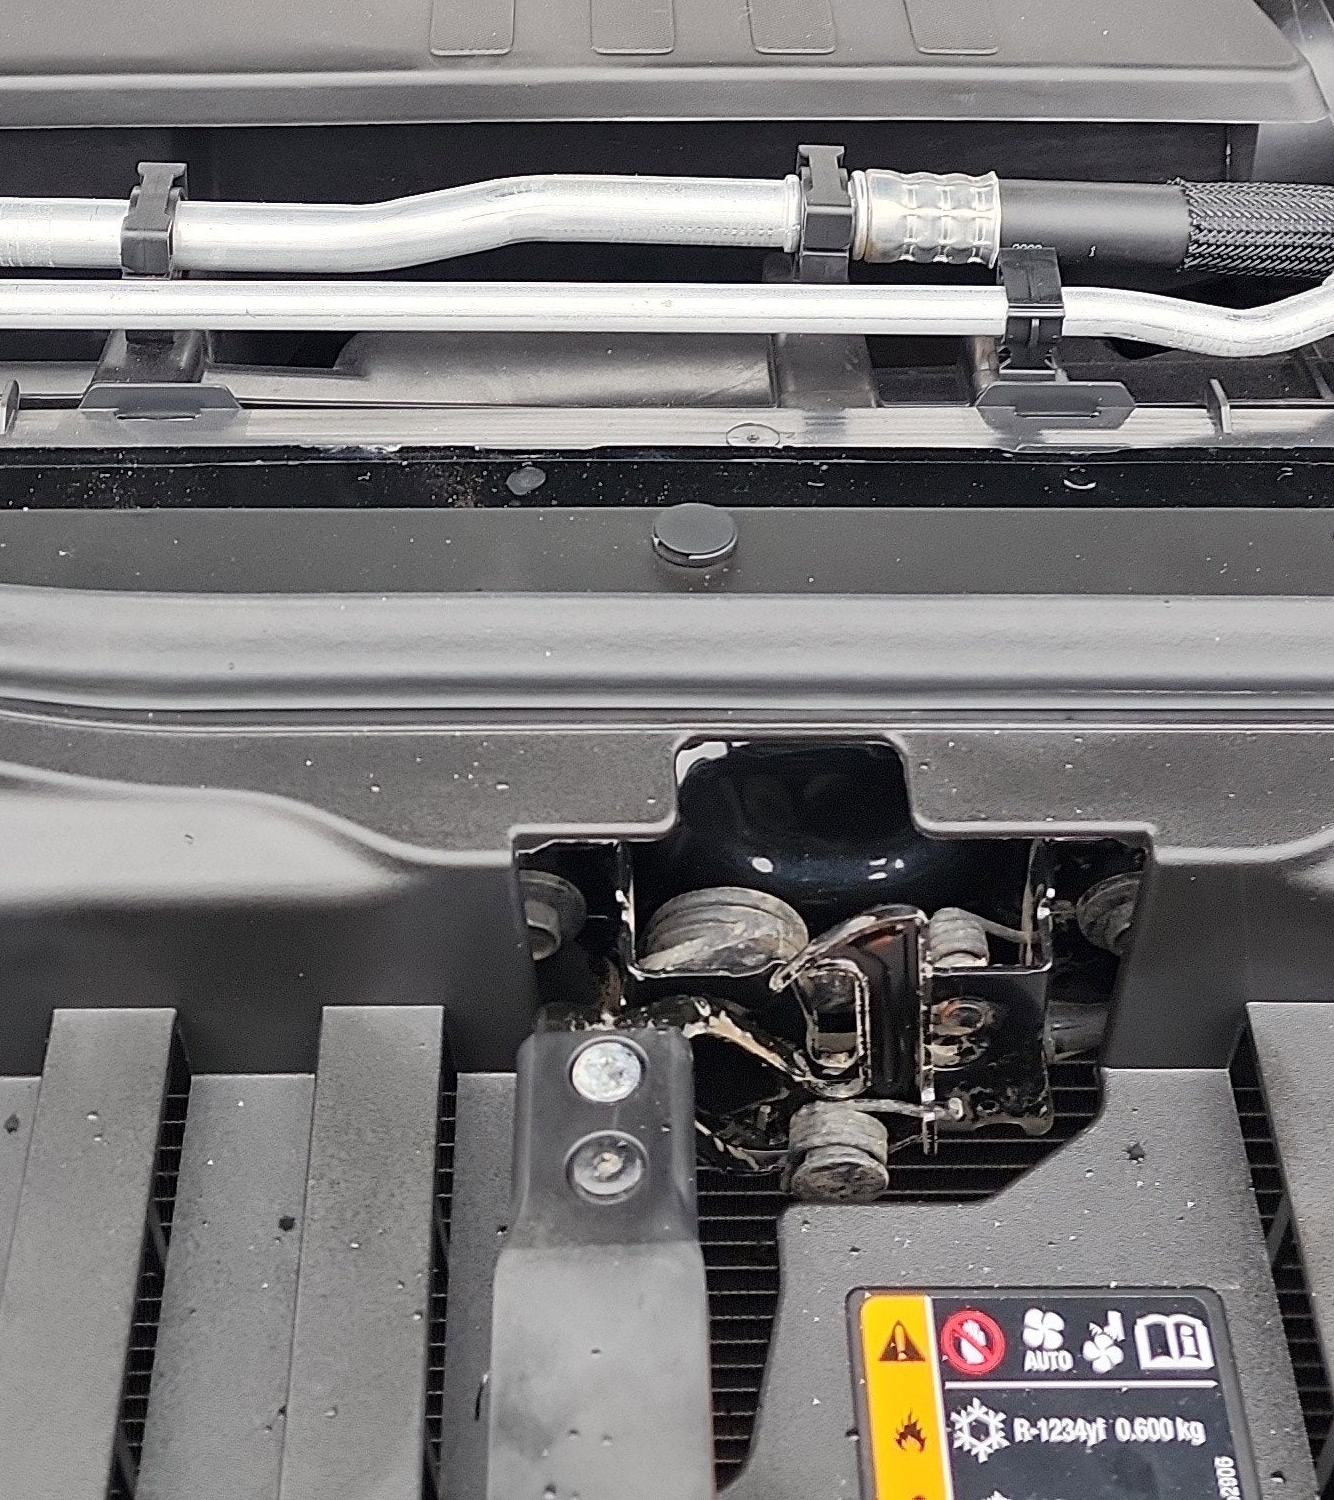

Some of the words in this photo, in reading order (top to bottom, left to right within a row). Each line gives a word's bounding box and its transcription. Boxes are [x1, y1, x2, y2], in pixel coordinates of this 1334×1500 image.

[1024, 1349, 1074, 1372] AUTO
[1013, 1417, 1107, 1447] R-1234yf
[1115, 1417, 1174, 1442] 0.600
[1175, 1416, 1207, 1446] kg
